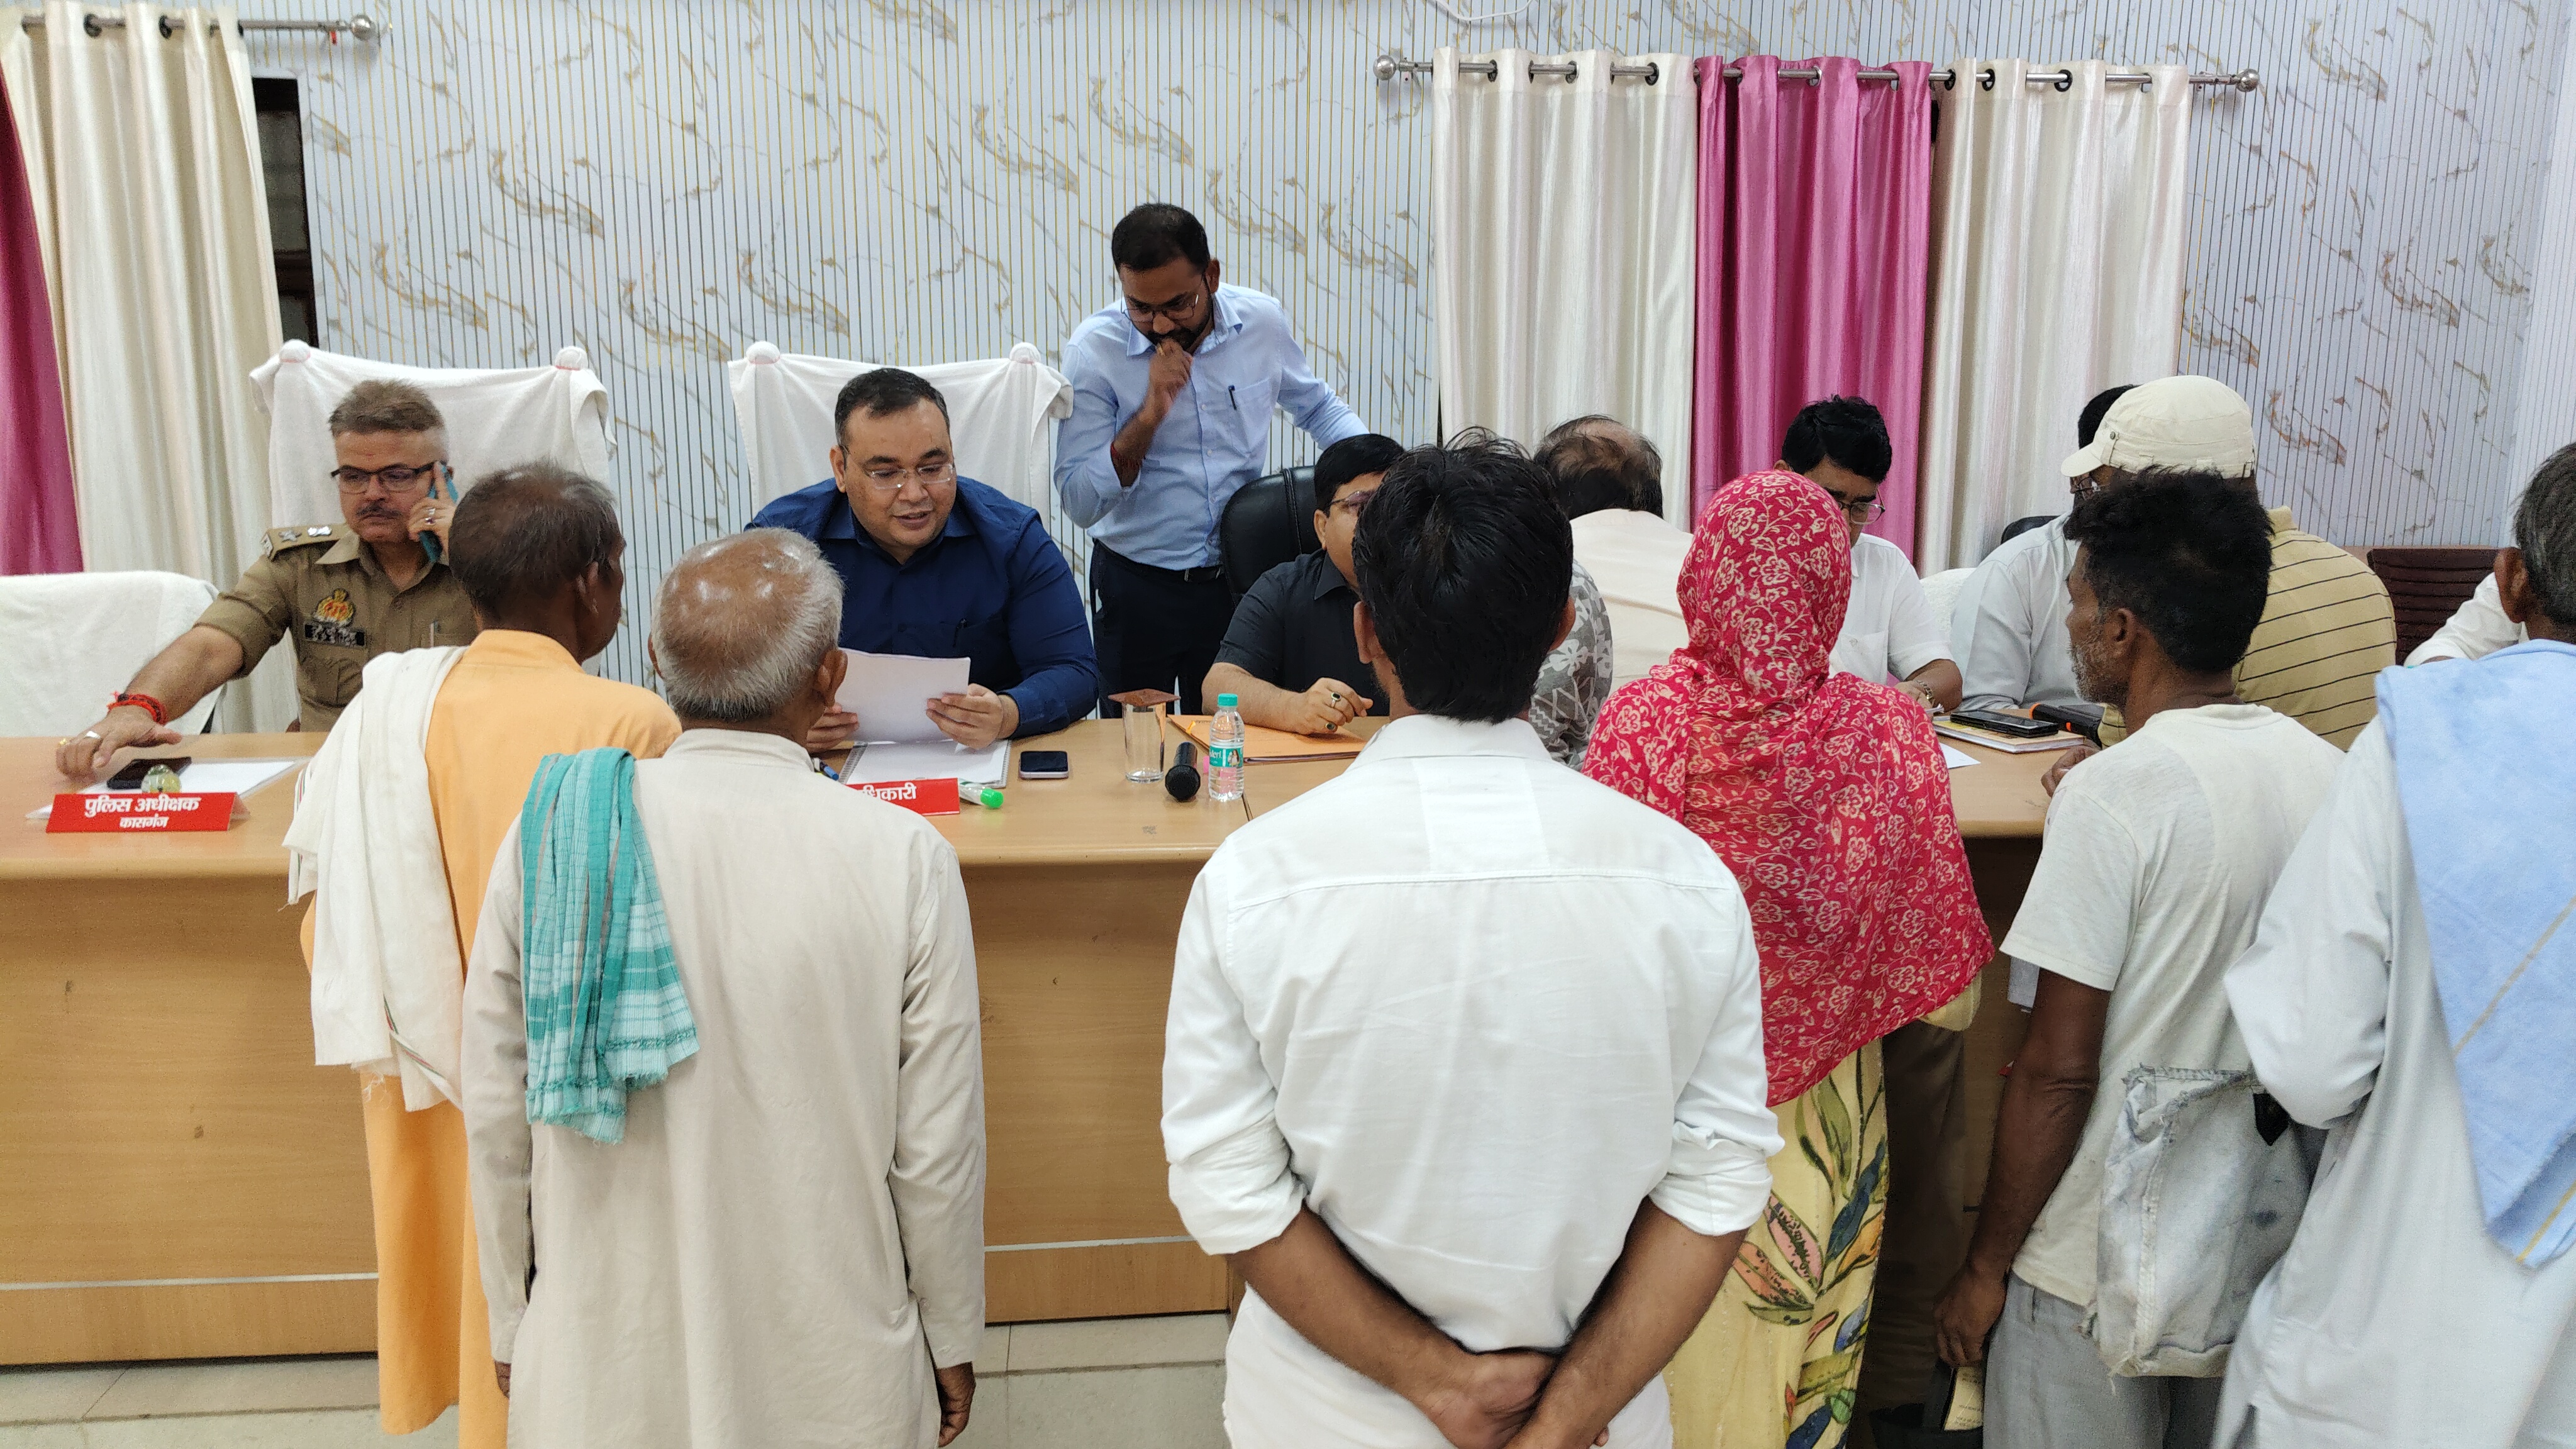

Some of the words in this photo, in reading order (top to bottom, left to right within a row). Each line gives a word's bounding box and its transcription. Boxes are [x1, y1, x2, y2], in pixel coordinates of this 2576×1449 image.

[862, 782, 917, 801] धिकारी
[84, 794, 133, 818] पुलिस
[135, 794, 201, 812] अधीक्षक
[119, 814, 169, 828] कासगंज
